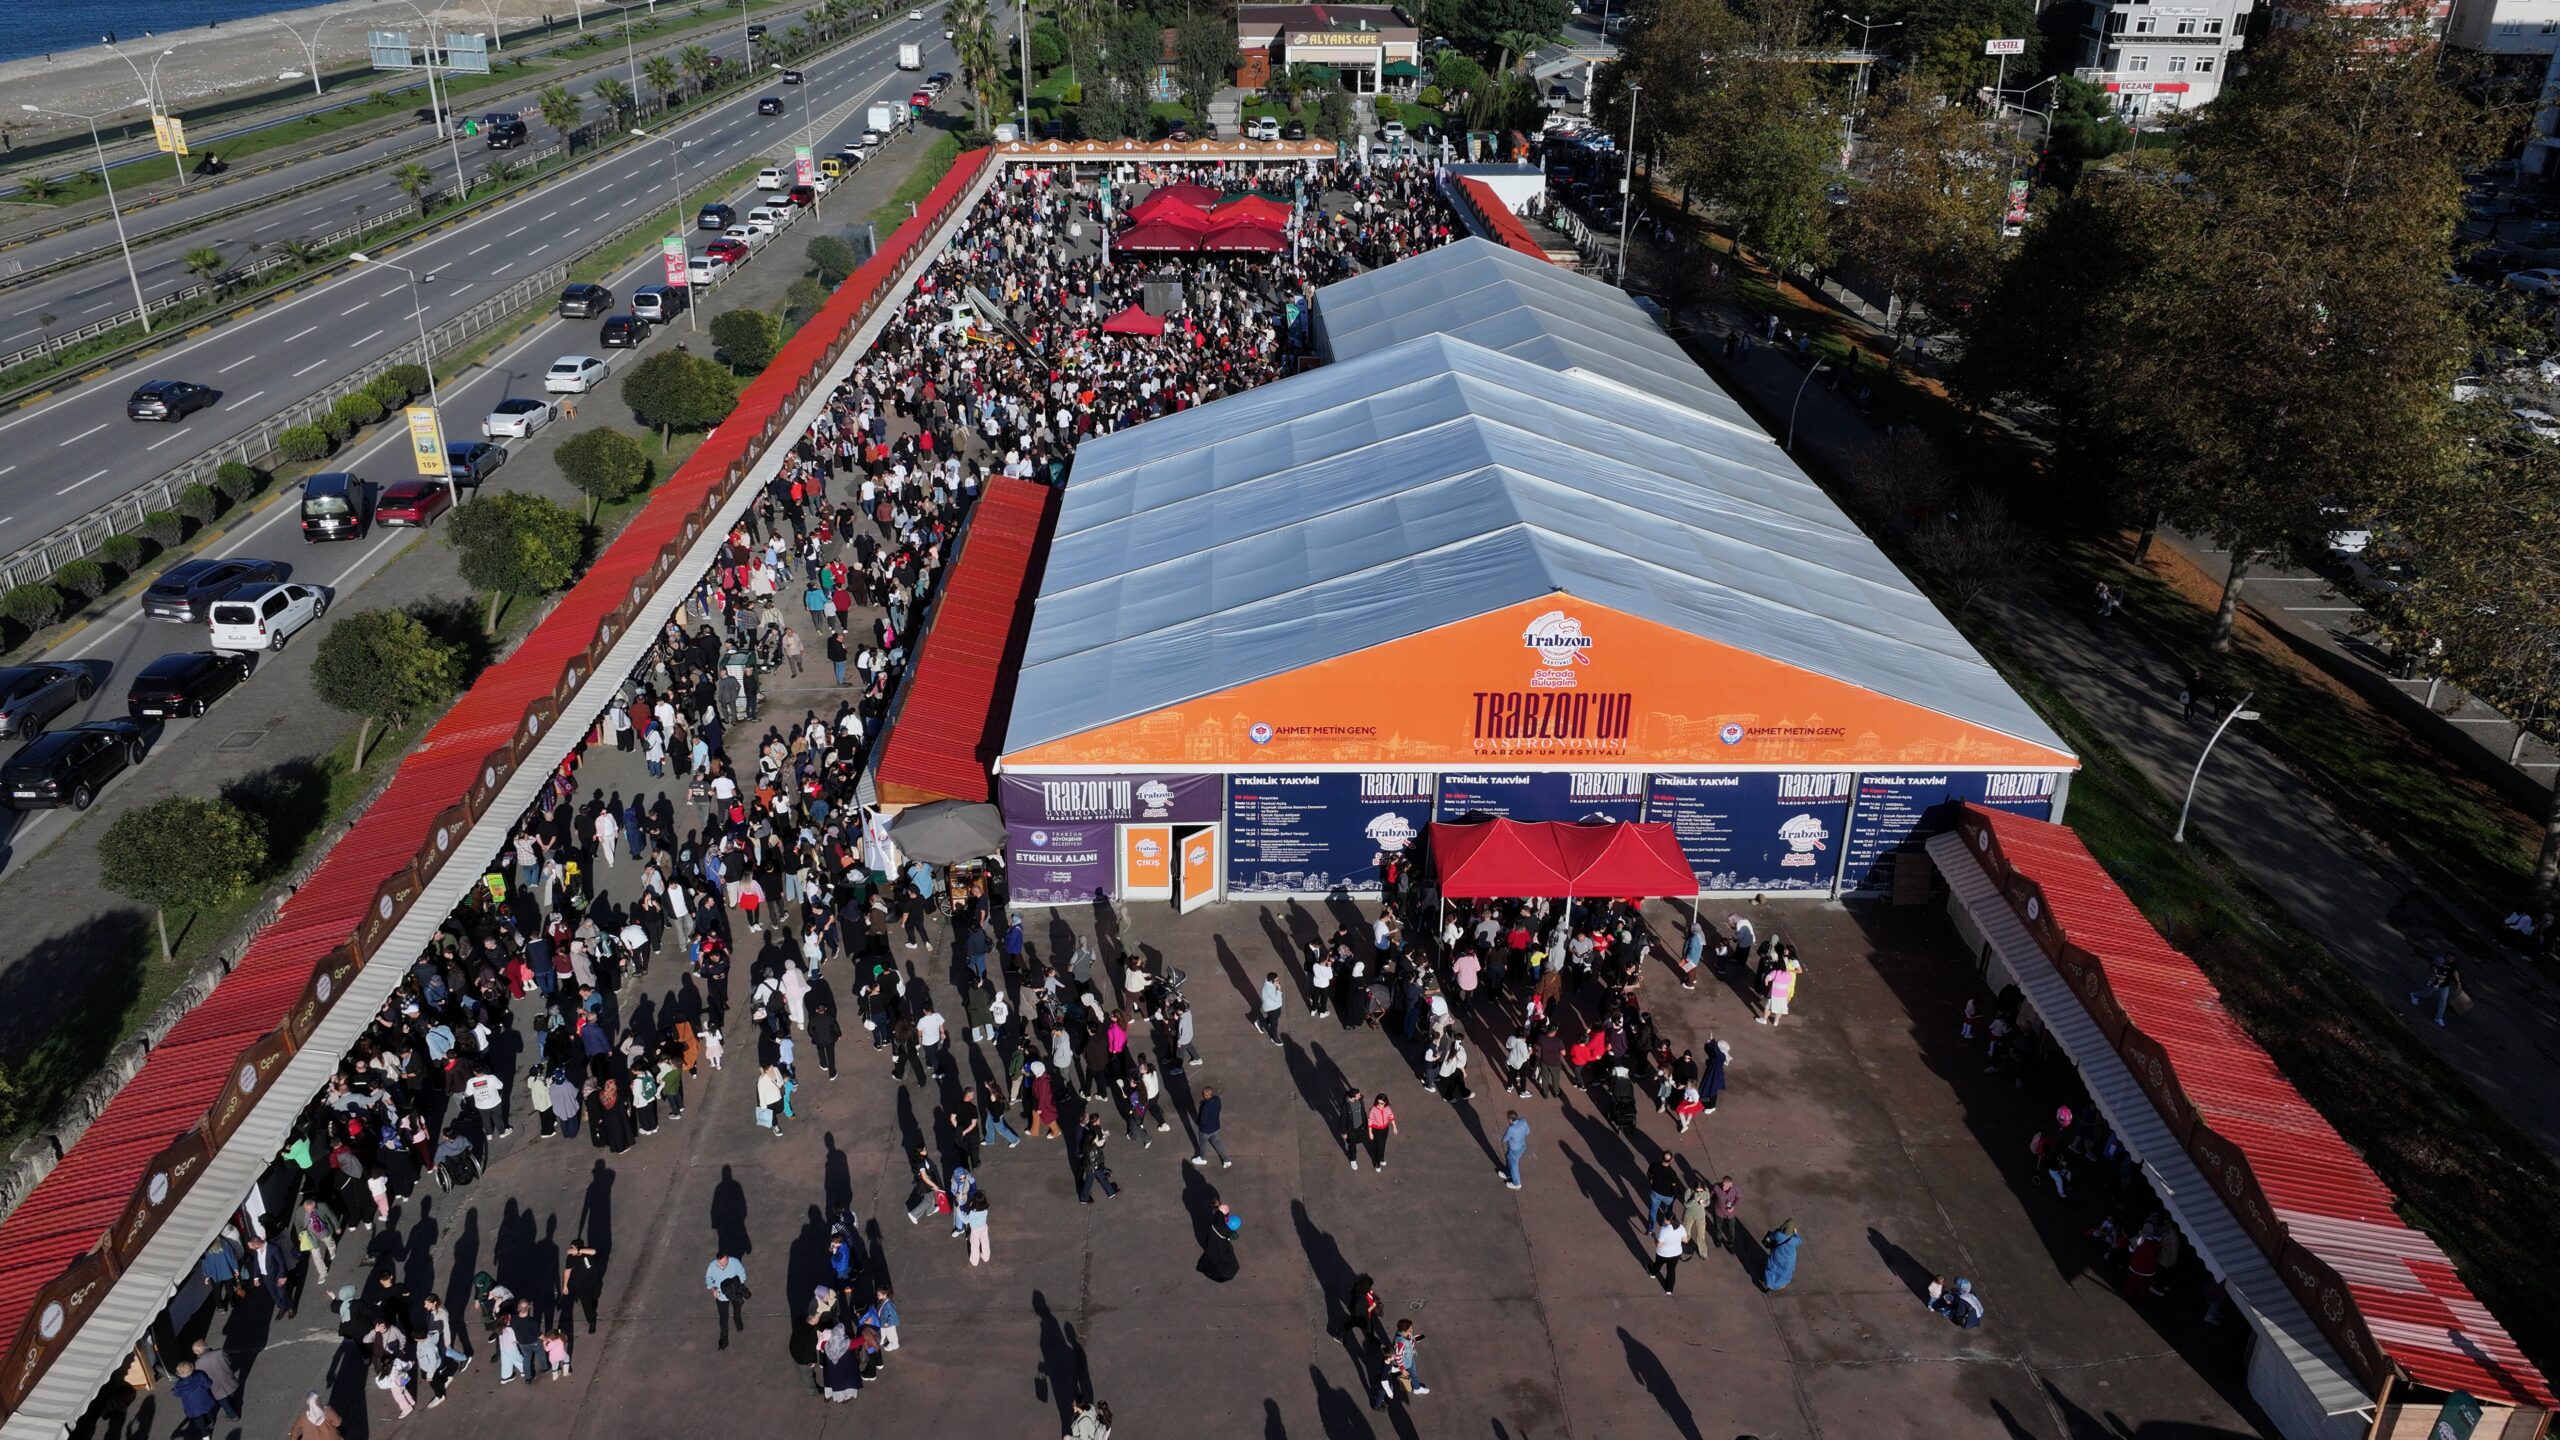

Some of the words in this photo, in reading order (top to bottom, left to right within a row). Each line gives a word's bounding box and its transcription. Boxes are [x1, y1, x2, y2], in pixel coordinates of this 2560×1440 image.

[1309, 34, 1352, 45] ALYANS
[1353, 35, 1377, 44] CAFE
[1993, 41, 2020, 49] VESTEL
[1524, 634, 1590, 646] Trabzon
[1532, 679, 1576, 687] Buluşalım
[1276, 726, 1312, 734] AHMET
[1314, 724, 1345, 734] METİN
[1347, 726, 1376, 736] GENÇ
[1747, 728, 1782, 736] AHMET
[1784, 726, 1814, 736] METİN
[1816, 728, 1846, 737] GENÇ
[1235, 776, 1278, 785] ETKİNLİK
[1282, 776, 1320, 785] TAKVİMİ
[1446, 775, 1488, 784] ETKİNLİK
[1492, 775, 1530, 784] TAKVİMİ
[1655, 776, 1698, 786] ETKİNLİK
[1700, 776, 1738, 786] TAKVİMİ
[1863, 776, 1906, 785] ETKİNLİK
[1908, 776, 1946, 785] TAKVİMİ
[1368, 828, 1416, 837] Trabzon
[1780, 830, 1828, 838] Trabzon
[1066, 854, 1098, 862] ALANI
